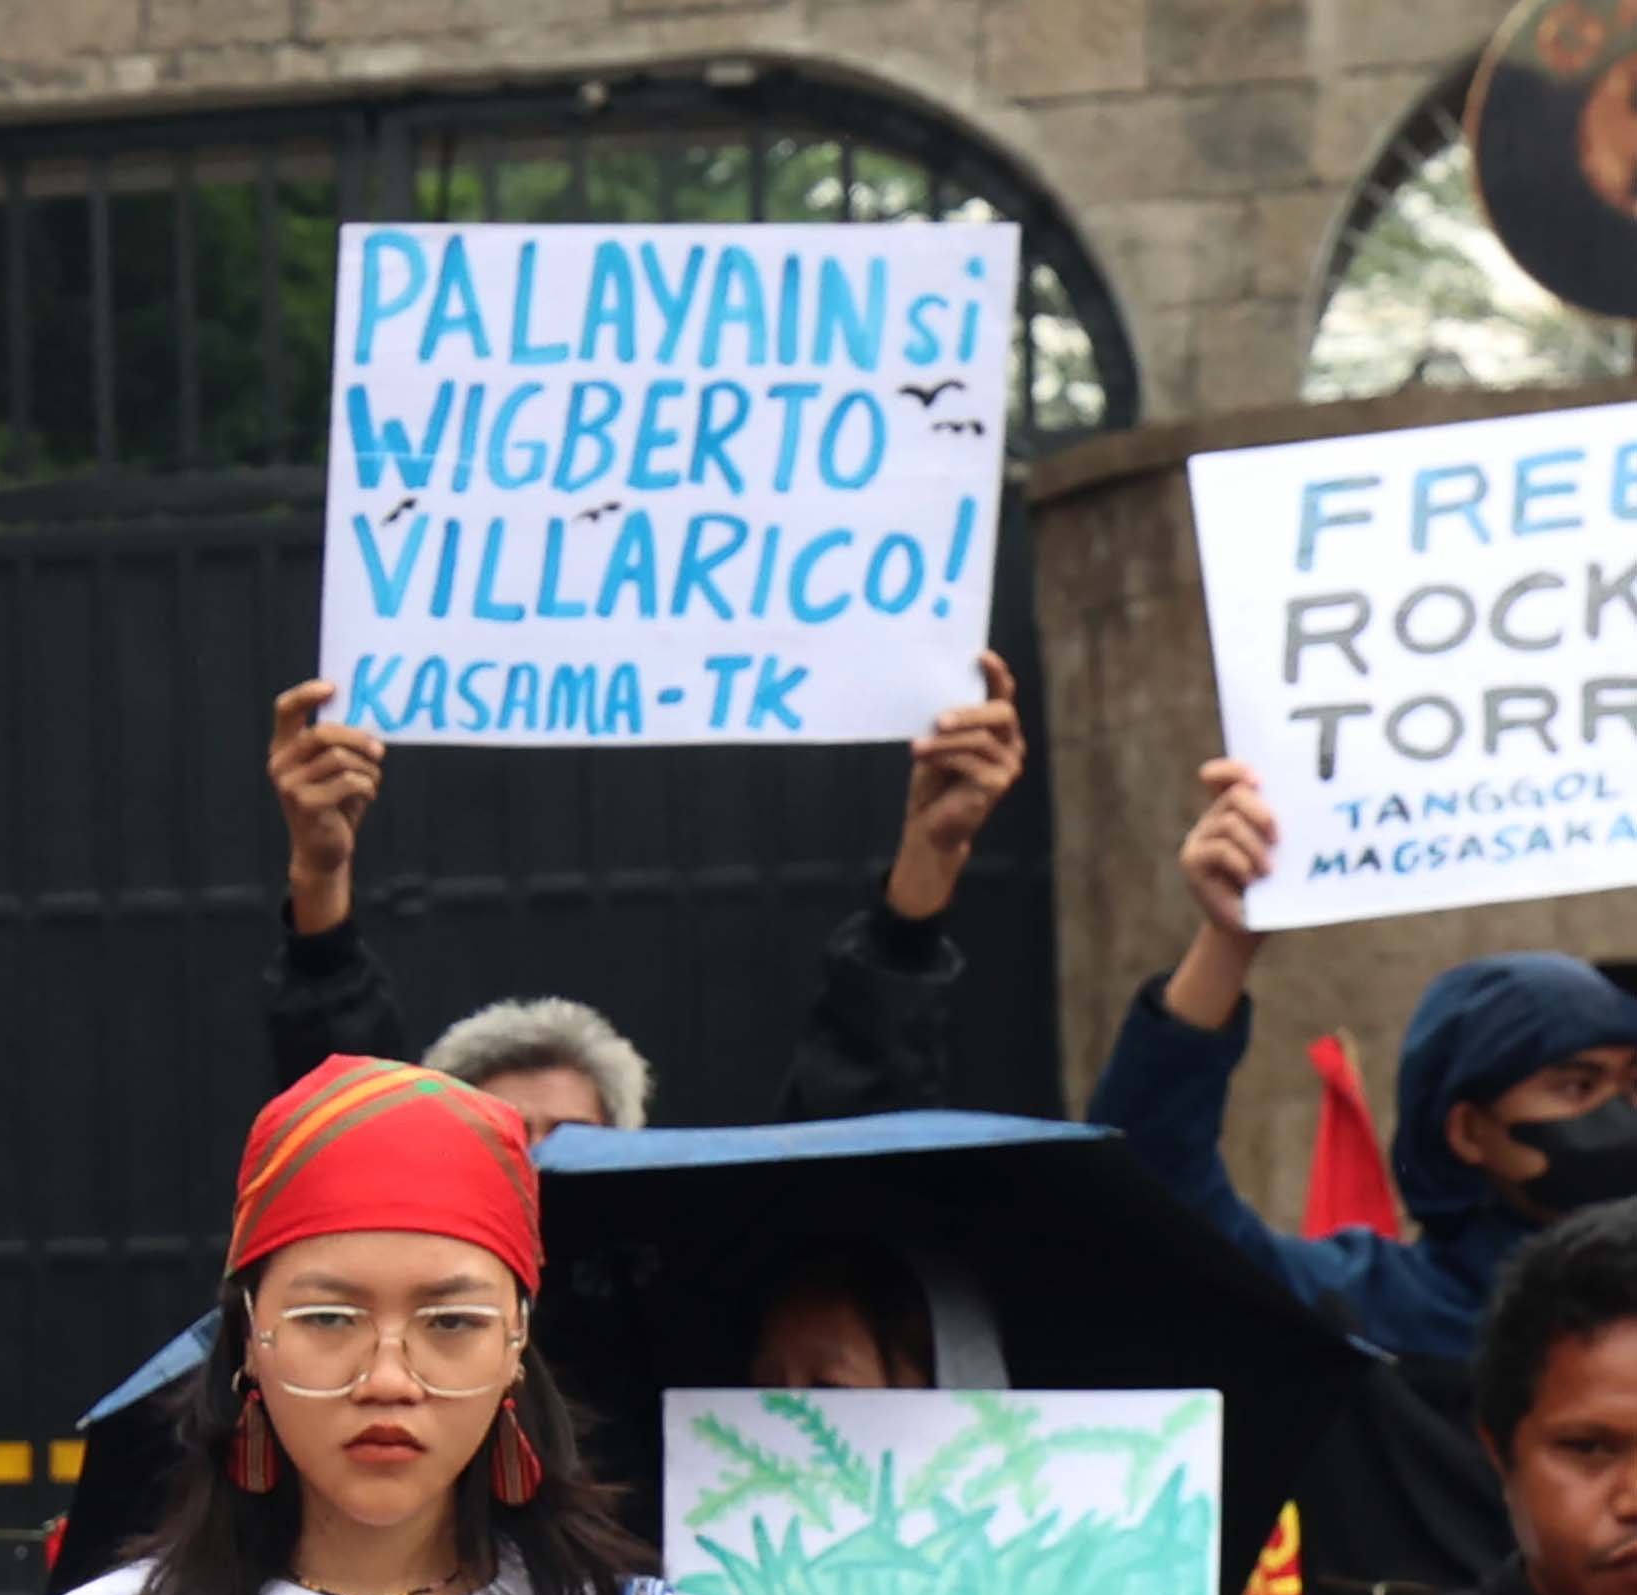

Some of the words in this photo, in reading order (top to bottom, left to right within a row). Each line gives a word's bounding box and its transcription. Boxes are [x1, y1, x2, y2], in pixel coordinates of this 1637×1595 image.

[354, 230, 888, 371] PALAYAIN
[902, 256, 986, 366] si
[346, 379, 888, 494] WIGBERTO
[352, 495, 978, 624] VILLARICO!
[1333, 770, 1623, 832] TANGGOL
